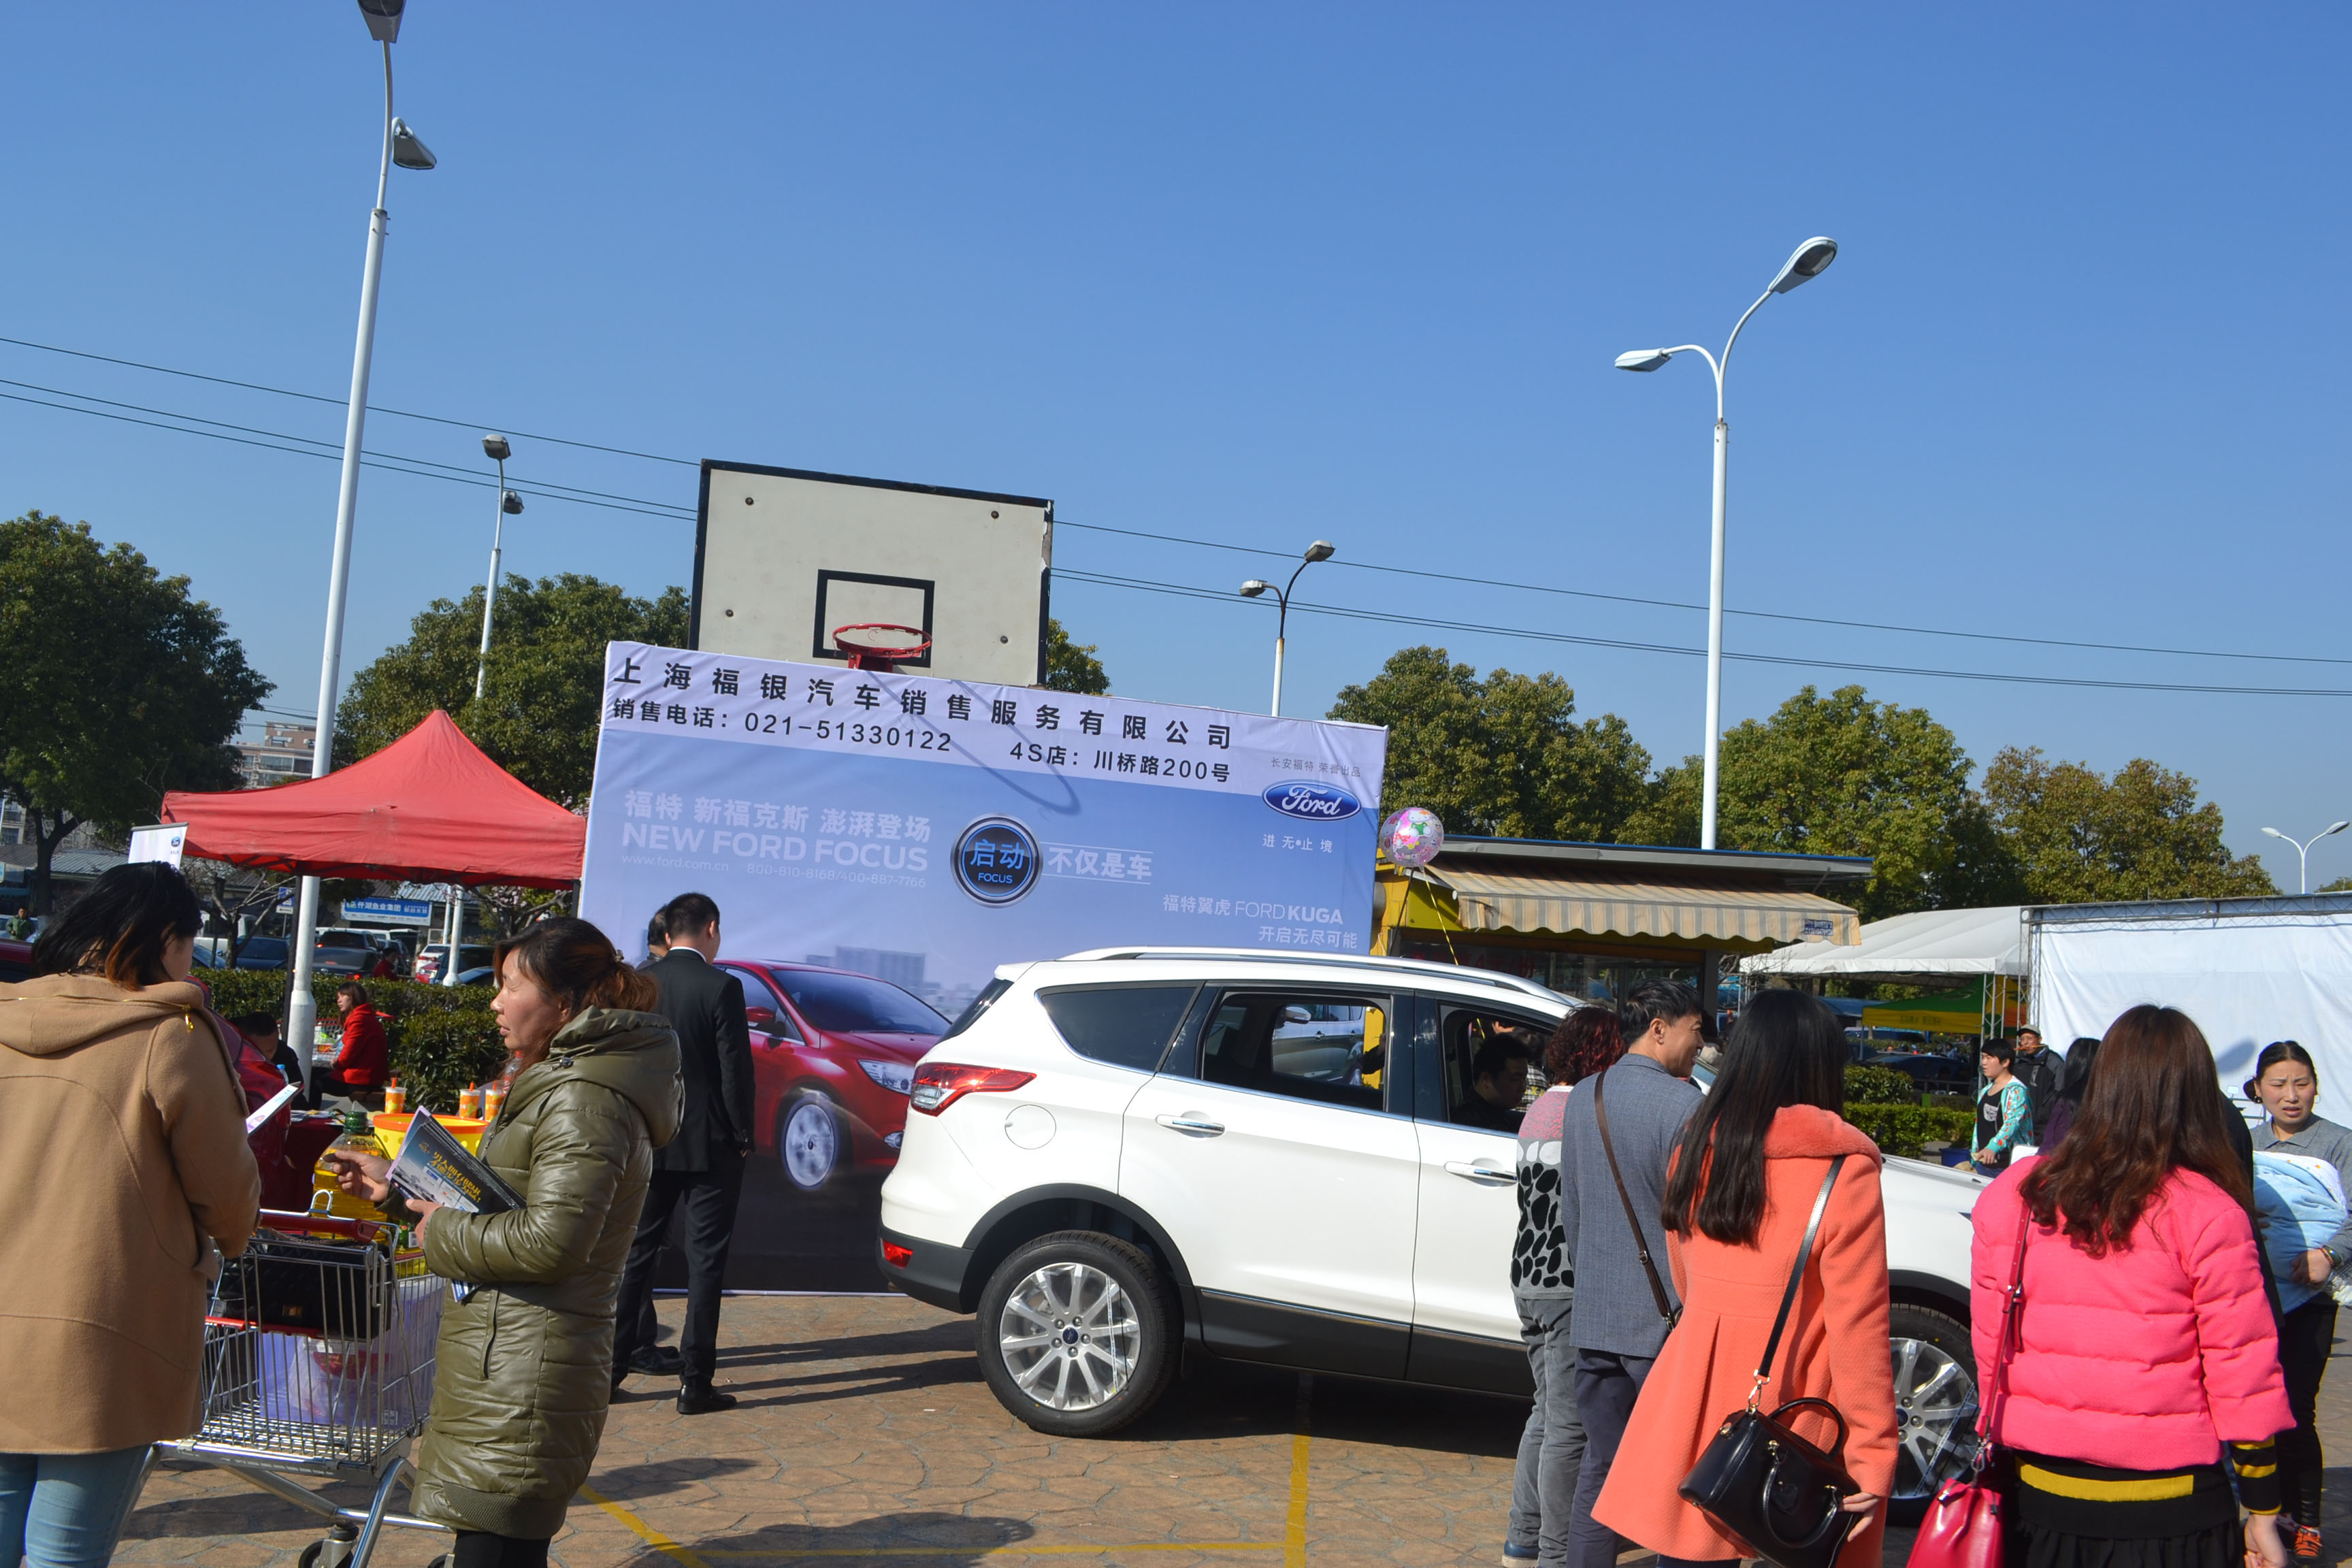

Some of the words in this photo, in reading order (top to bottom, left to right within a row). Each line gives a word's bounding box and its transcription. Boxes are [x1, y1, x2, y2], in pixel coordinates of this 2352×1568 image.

[613, 657, 1230, 749] 上海福银汽车销售服务有限公司
[1281, 785, 1343, 815] Ford
[624, 790, 683, 821] 福特
[693, 796, 809, 833] 新福克斯
[819, 808, 931, 843] 澎湃登场
[621, 822, 706, 853] NEW
[712, 830, 807, 862] FORD
[814, 838, 928, 872] FOCUS
[621, 854, 729, 872] www.ford.com.cn
[970, 838, 1024, 870] 启动
[977, 872, 1013, 884] FOCUS
[1048, 847, 1152, 880] 不仅是车
[1258, 926, 1358, 949] 开启无尽可能
